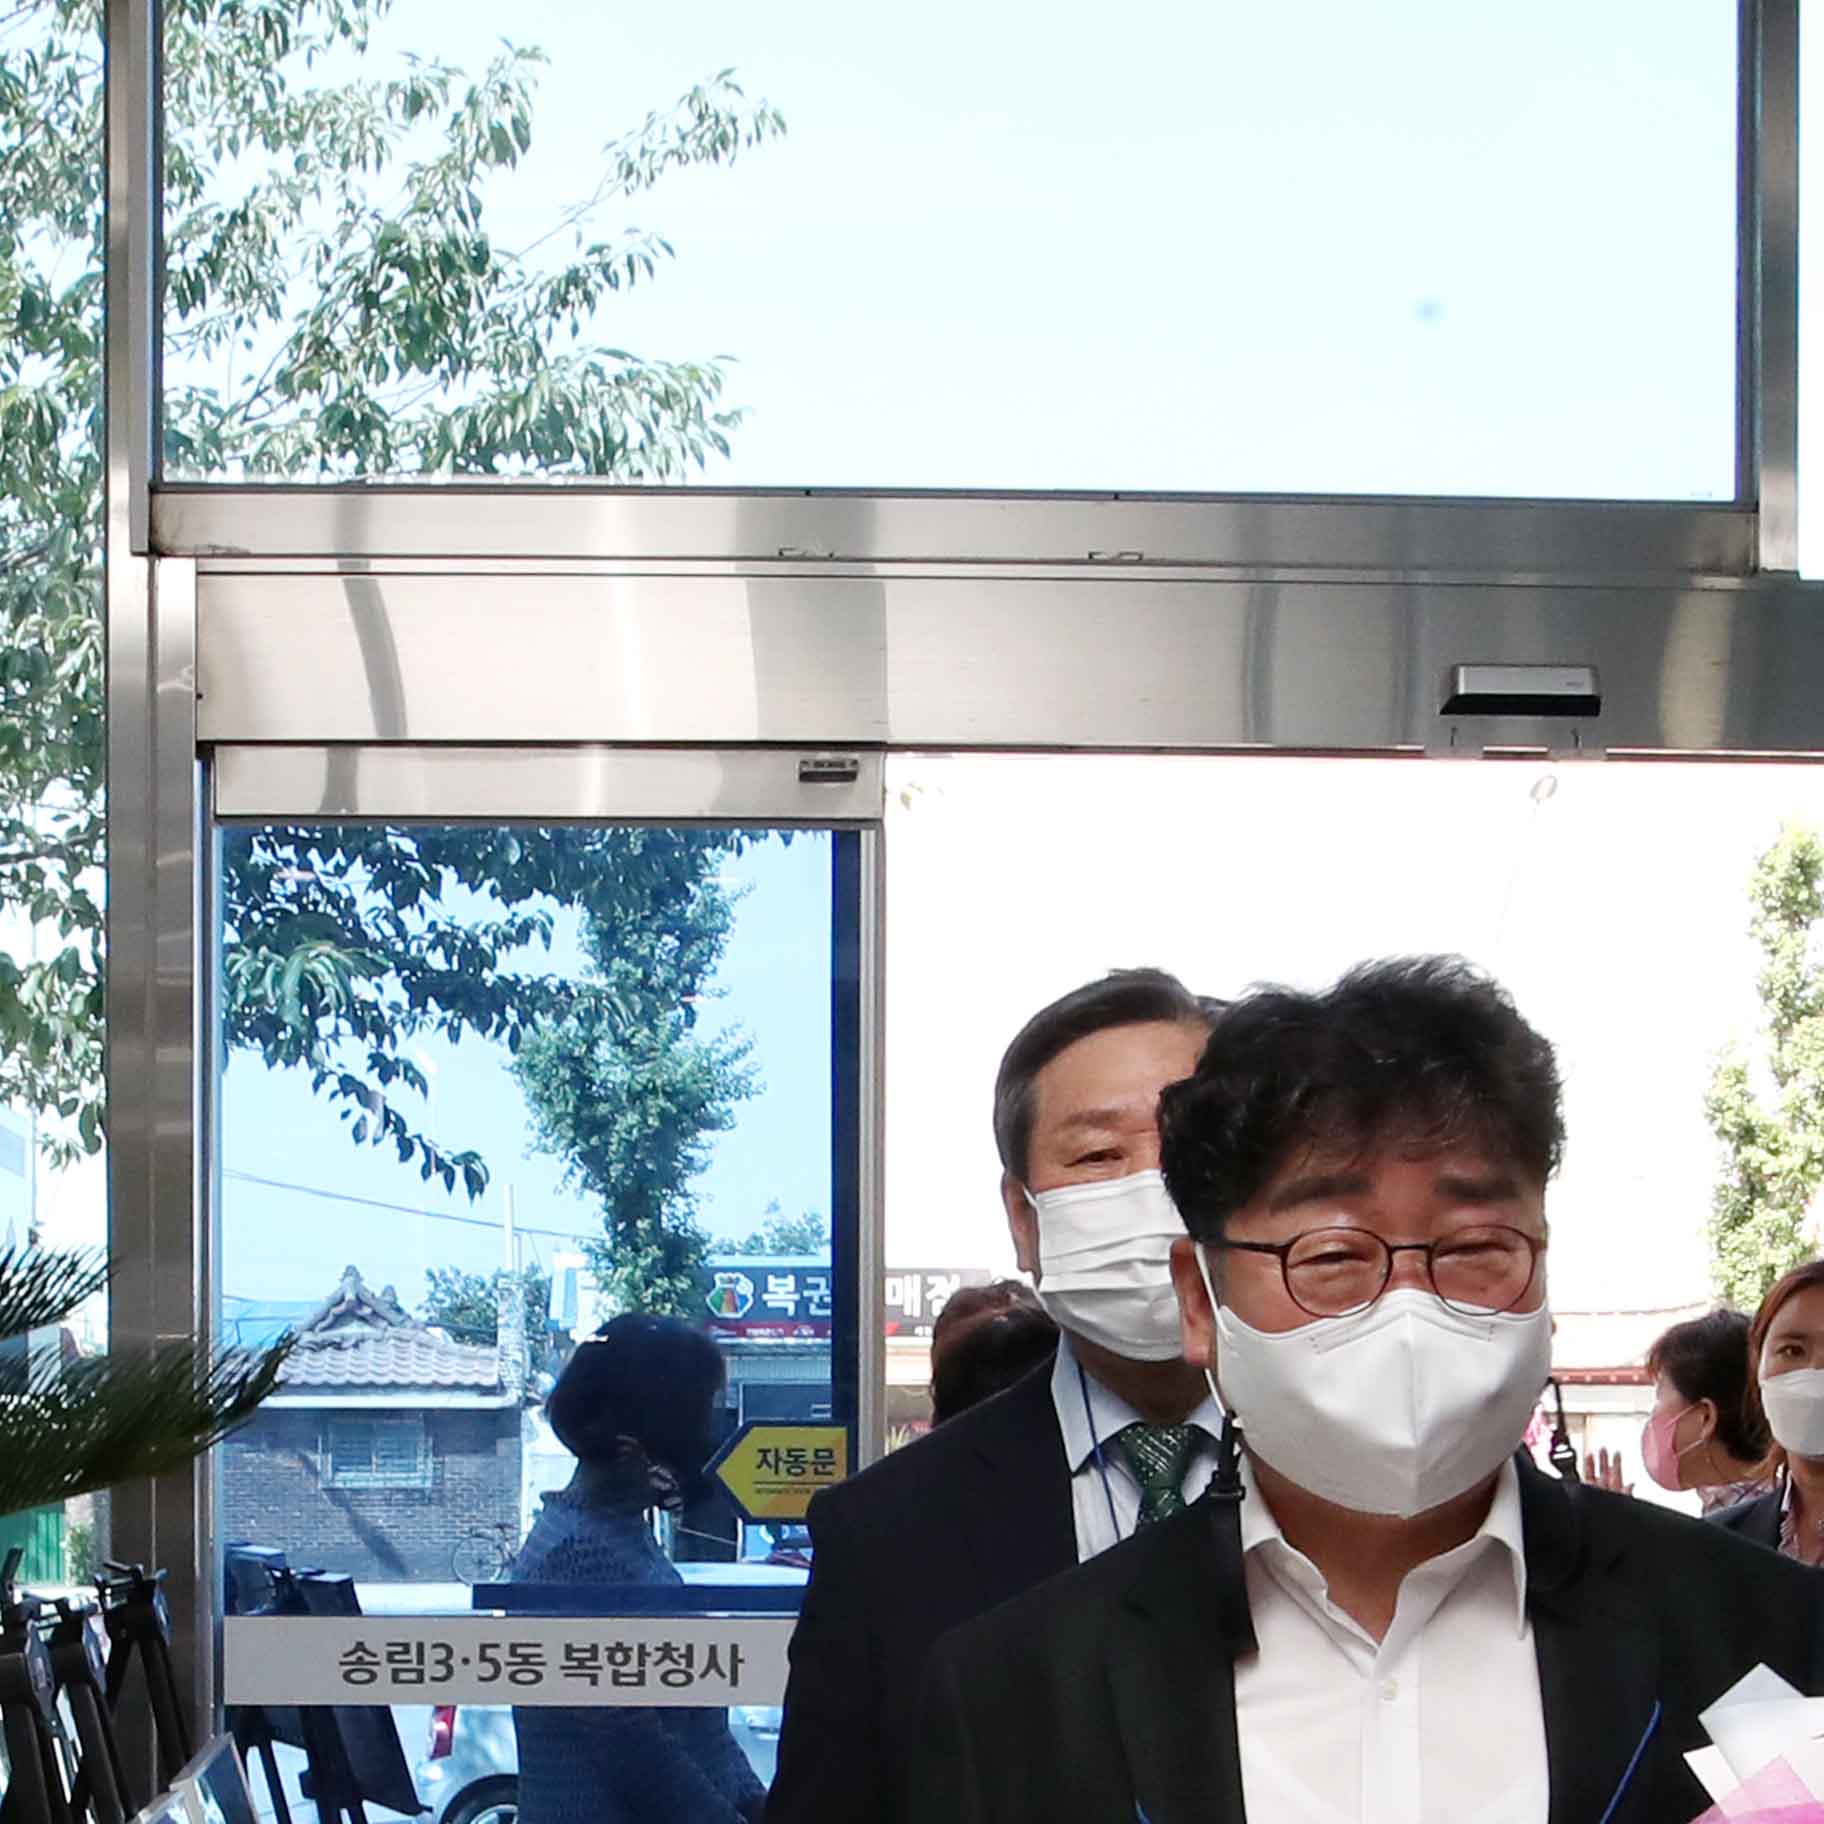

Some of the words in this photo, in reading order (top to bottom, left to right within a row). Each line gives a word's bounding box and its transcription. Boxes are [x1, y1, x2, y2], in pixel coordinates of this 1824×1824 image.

[756, 1447, 837, 1477] 자동문
[338, 1641, 547, 1686] 송림3·5동
[559, 1641, 745, 1688] 복합청사
